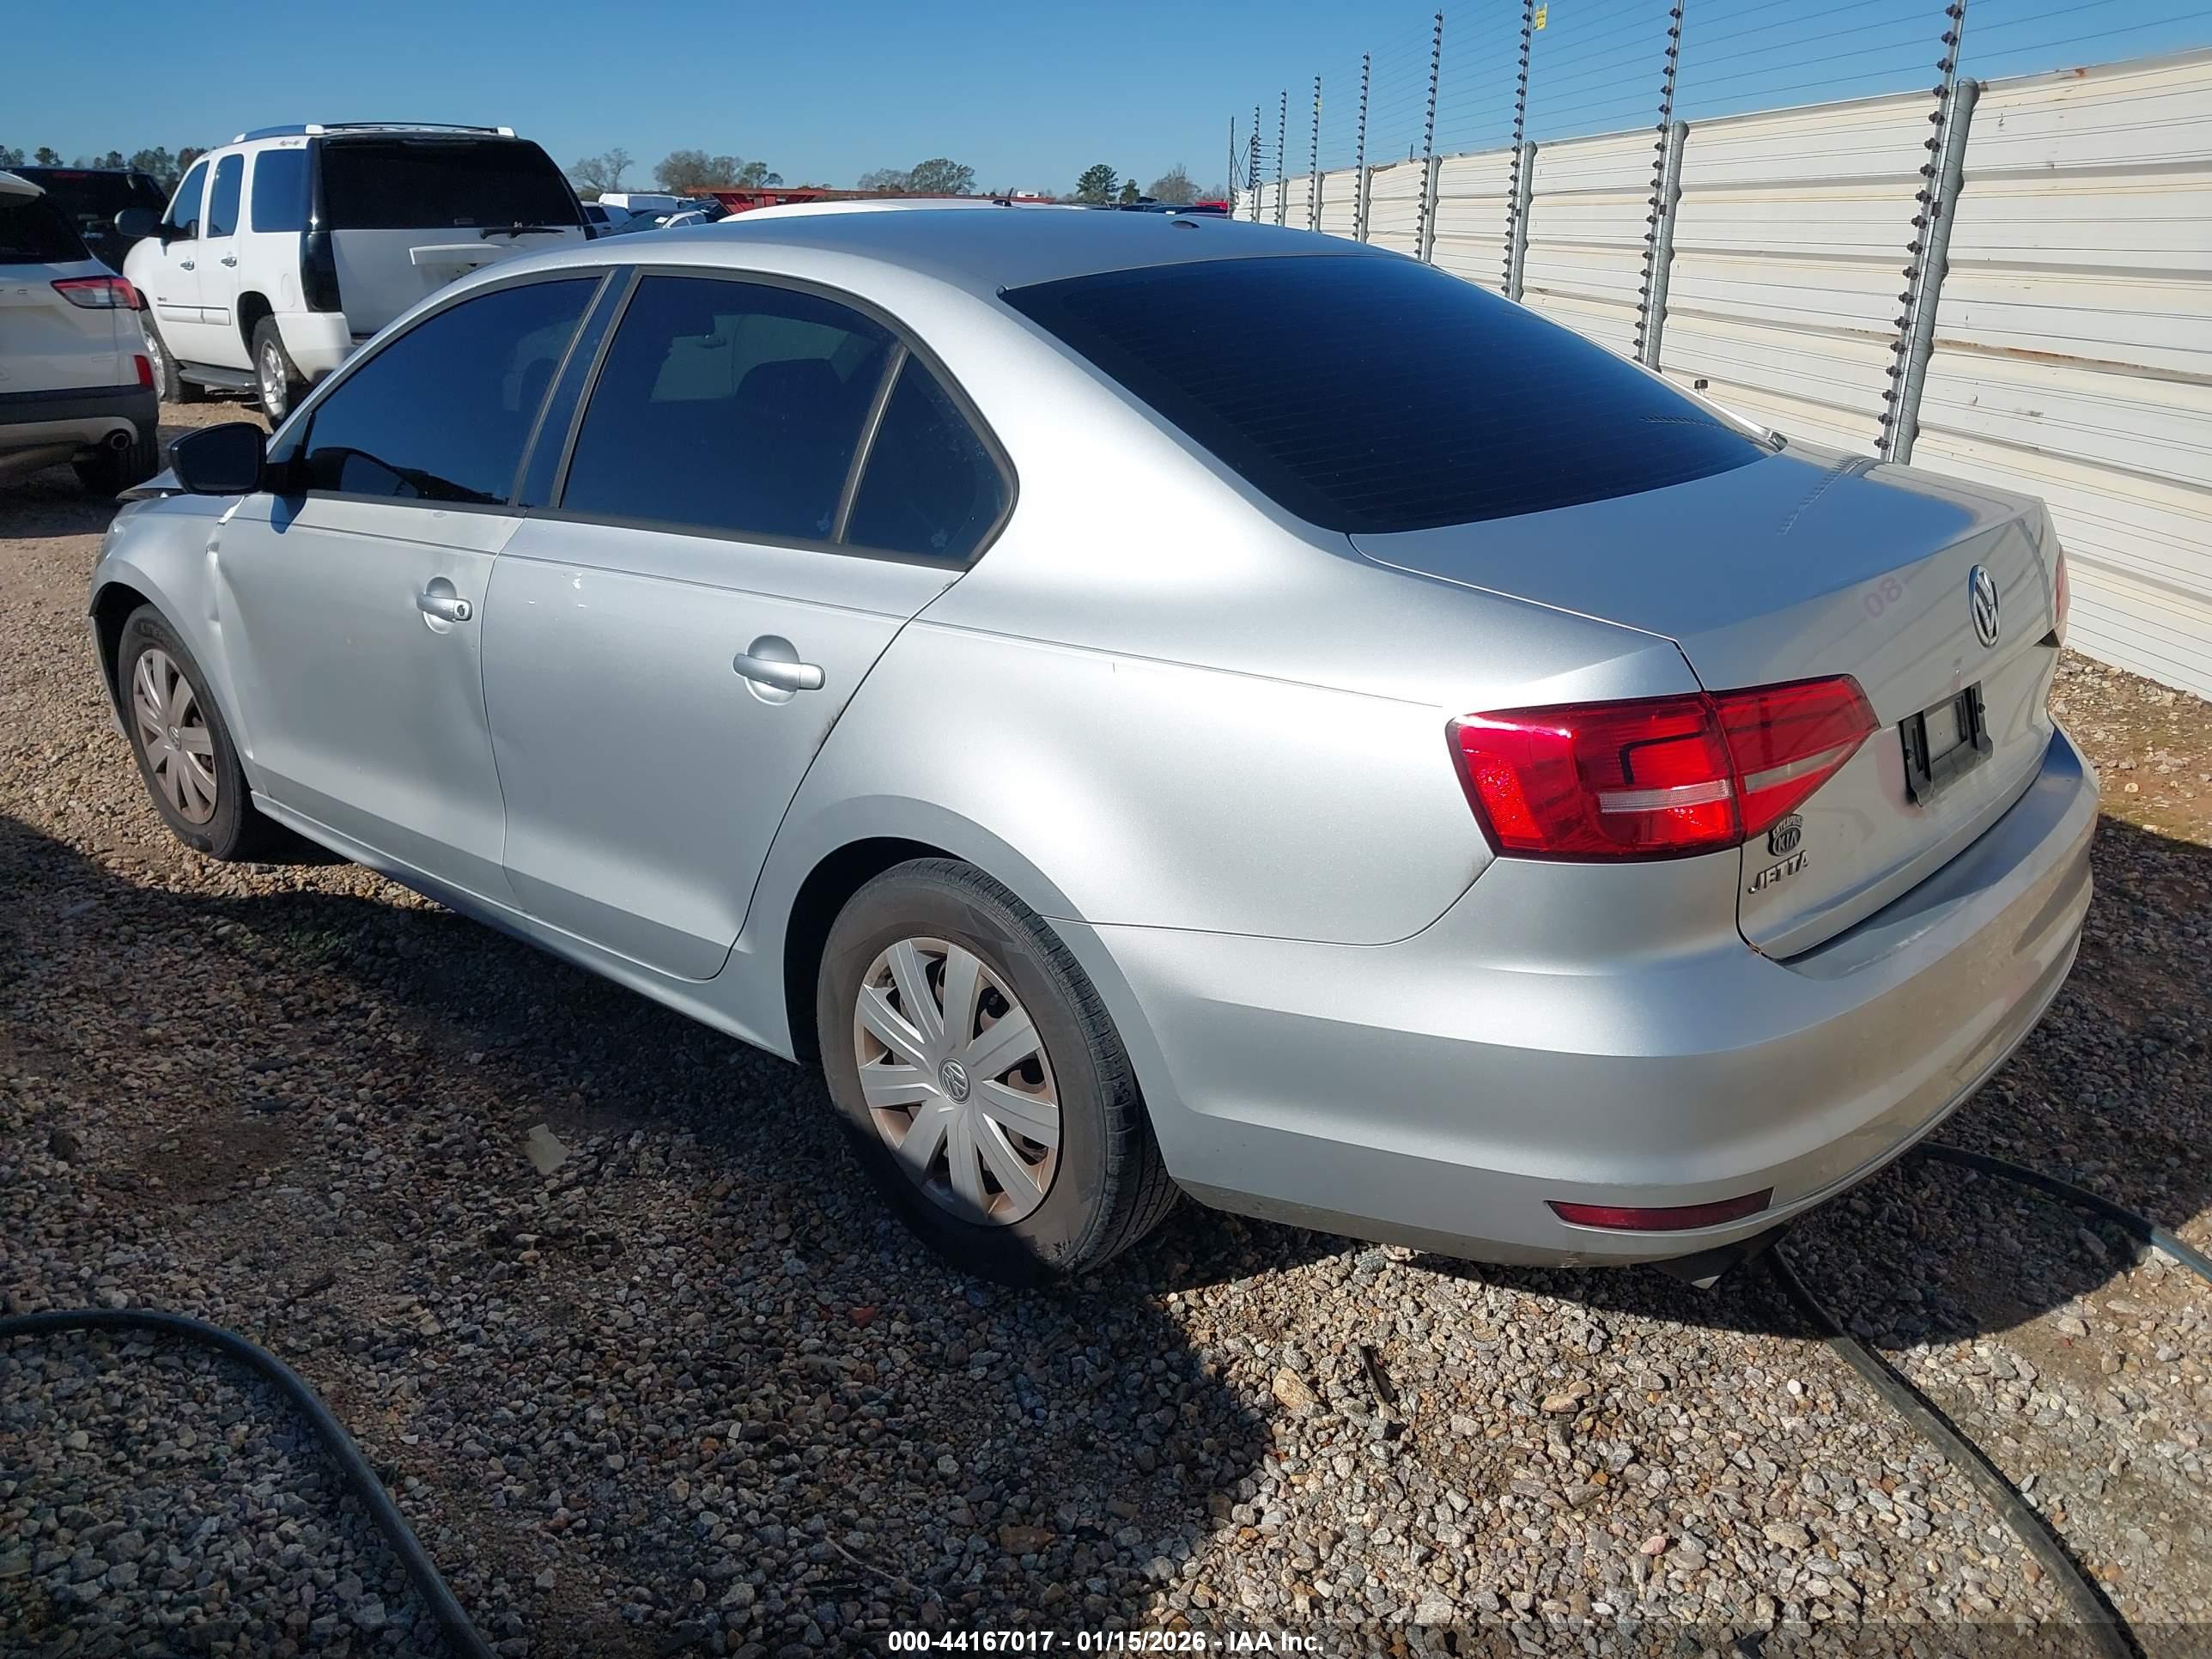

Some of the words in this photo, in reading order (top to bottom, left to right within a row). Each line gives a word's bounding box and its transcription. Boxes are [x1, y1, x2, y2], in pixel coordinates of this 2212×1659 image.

[1863, 576, 1904, 618] 08
[1778, 830, 1799, 853] KIA
[1748, 849, 1808, 894] JETTA
